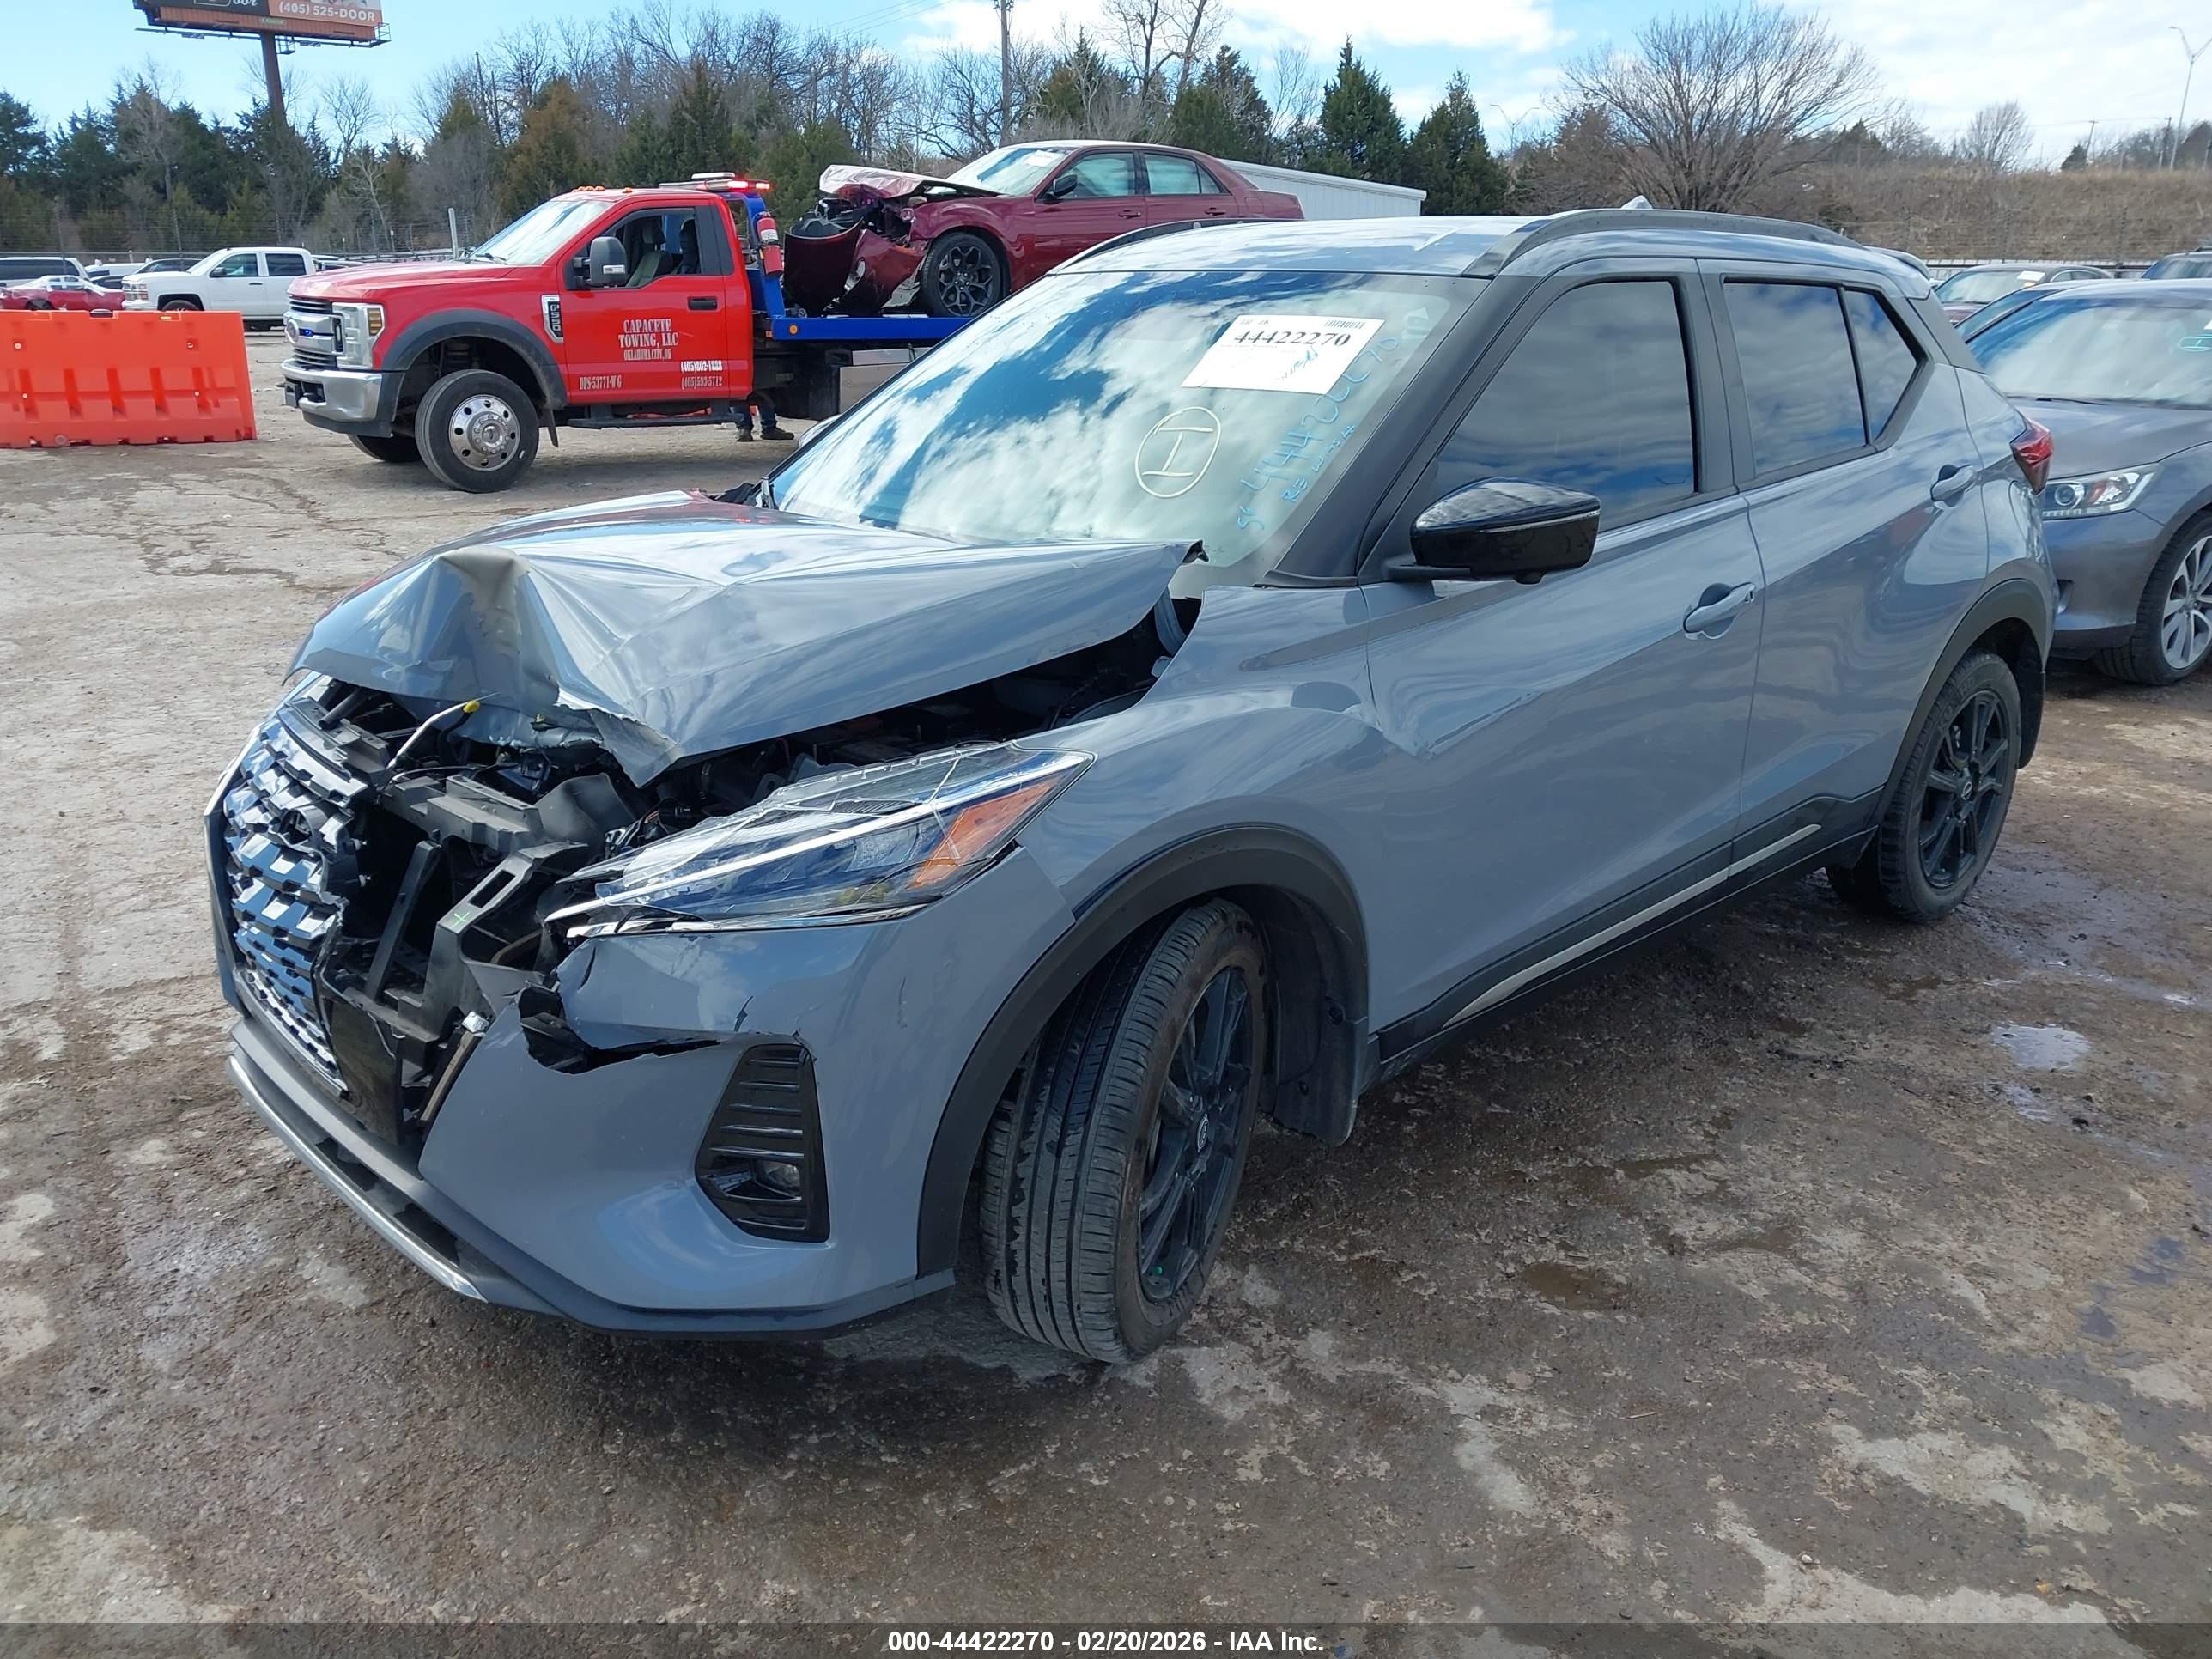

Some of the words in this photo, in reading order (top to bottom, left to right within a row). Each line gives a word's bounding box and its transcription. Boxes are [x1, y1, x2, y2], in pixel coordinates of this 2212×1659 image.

[279, 3, 310, 15] (405)
[313, 5, 375, 21] 525-DOOR
[623, 319, 672, 333] CAPACETE
[618, 333, 659, 348] TOWING,
[662, 332, 678, 346] LLC
[1234, 331, 1352, 347] 44422270
